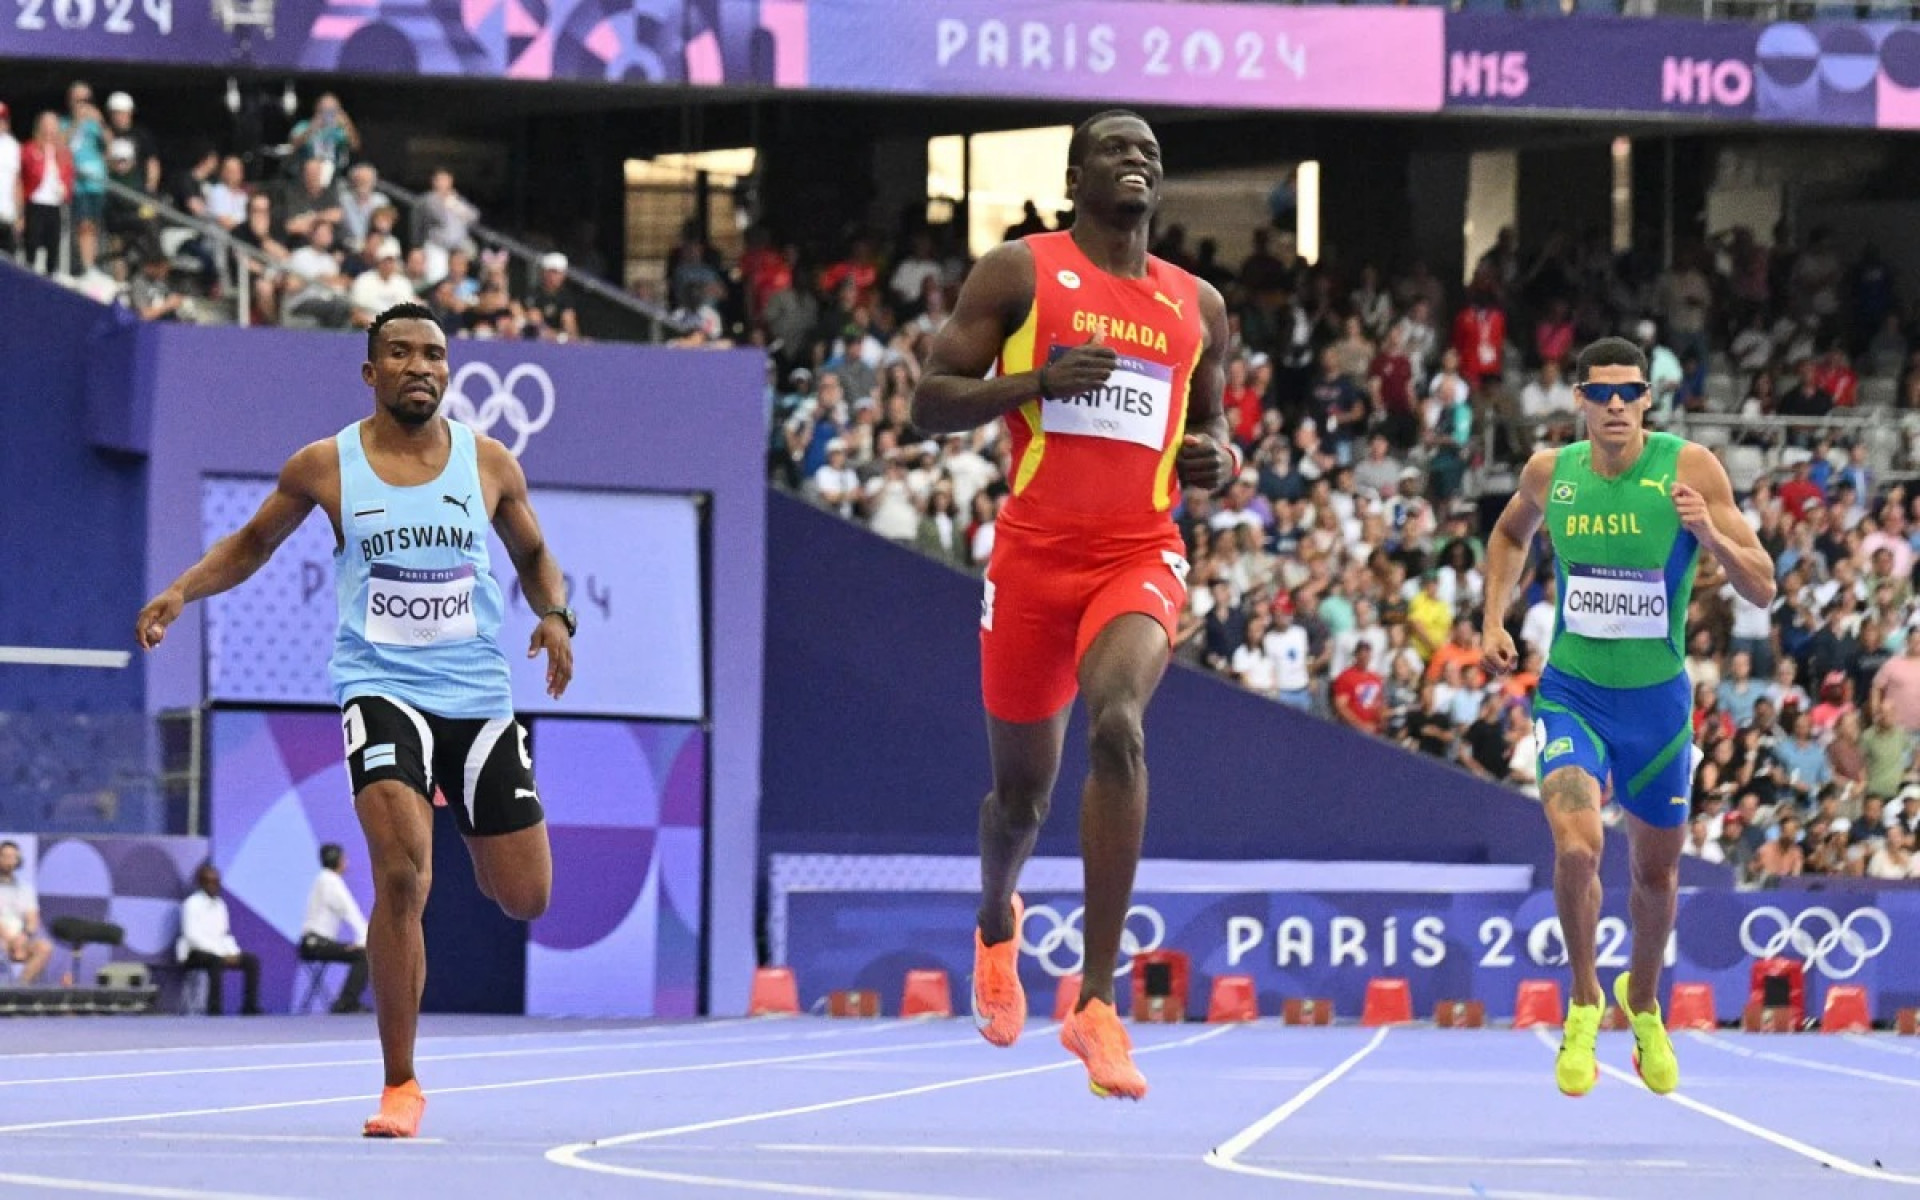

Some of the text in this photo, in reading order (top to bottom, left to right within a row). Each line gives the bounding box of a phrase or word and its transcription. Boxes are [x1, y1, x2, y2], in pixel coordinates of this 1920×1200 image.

[16, 0, 173, 35] 2024
[936, 18, 1306, 80] PARIS 2024
[1450, 51, 1529, 97] N15
[1661, 56, 1753, 106] N10
[1073, 309, 1167, 355] GRENADA
[1061, 384, 1153, 417] AMES
[1566, 513, 1641, 536] BRASIL
[362, 525, 473, 562] BOTSWANA
[371, 592, 470, 621] SCOTCH
[1568, 590, 1665, 617] CARVALHO
[1227, 916, 1446, 967] PARIS
